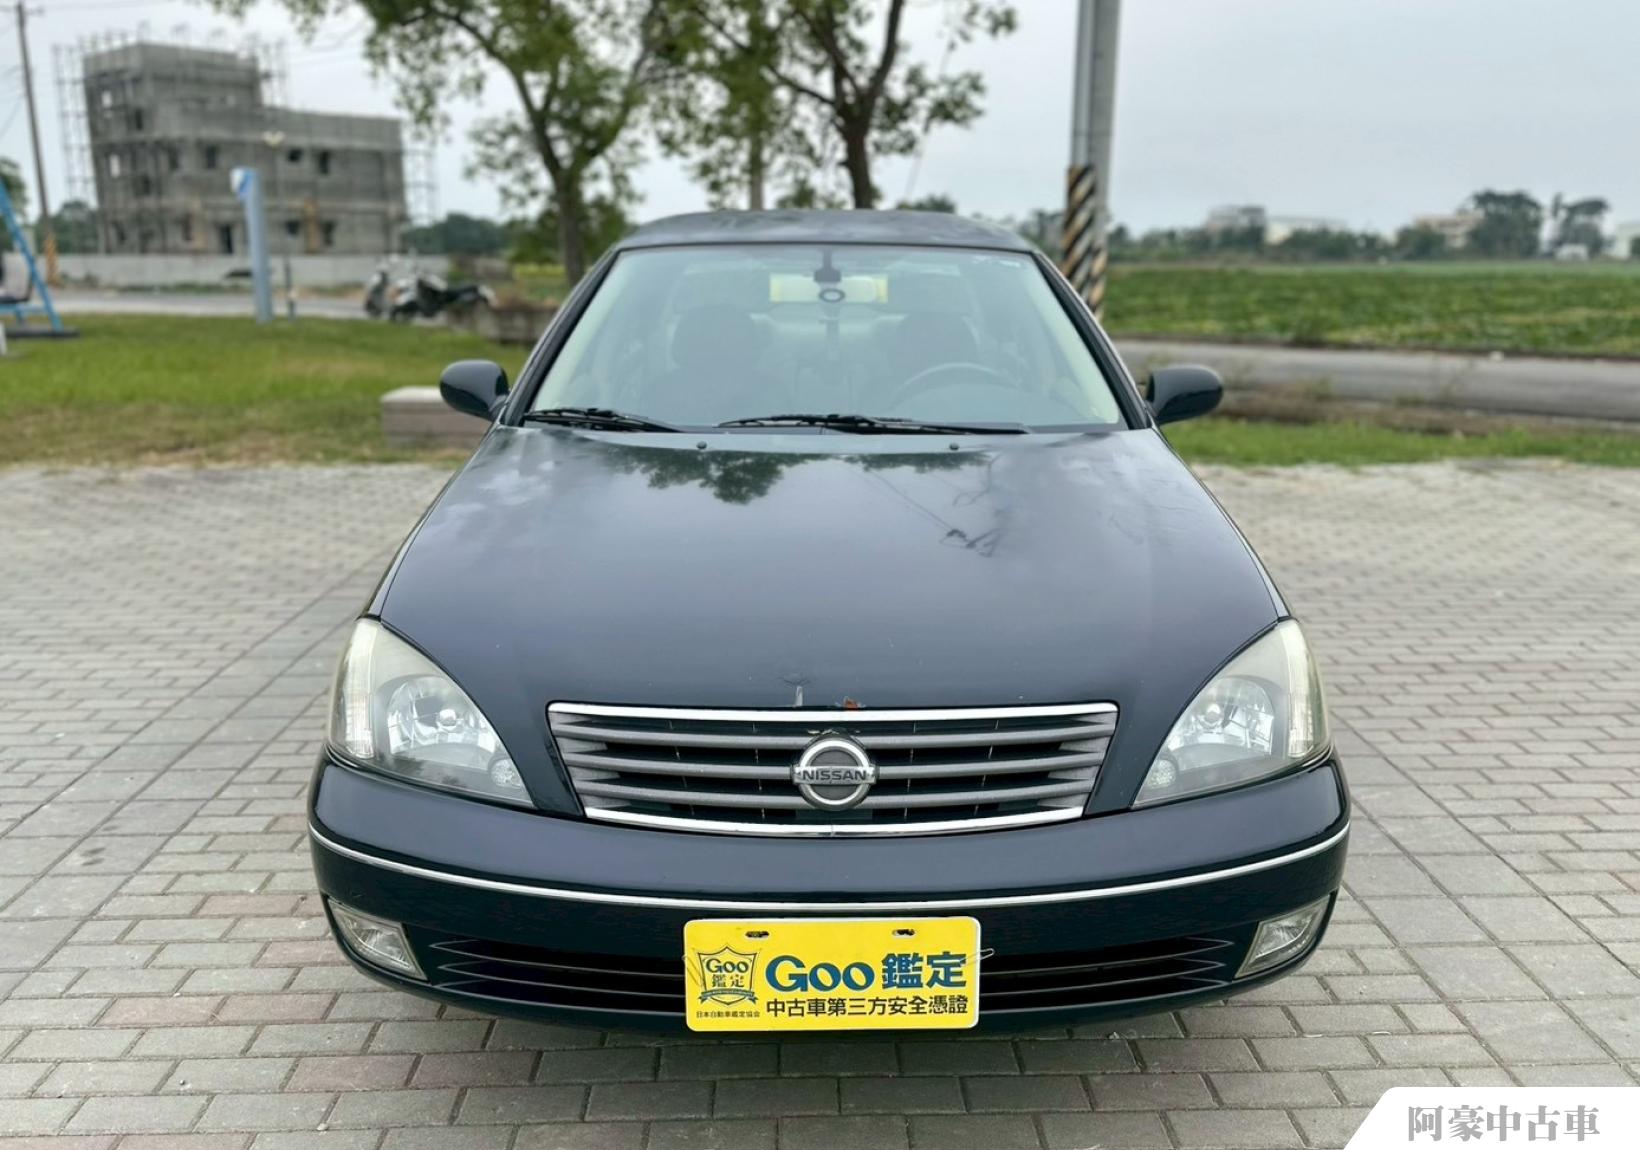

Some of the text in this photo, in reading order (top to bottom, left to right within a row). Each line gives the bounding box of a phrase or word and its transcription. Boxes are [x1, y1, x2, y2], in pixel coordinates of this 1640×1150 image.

[803, 769, 867, 781] NISSAN
[706, 958, 749, 973] Goo
[765, 951, 967, 992] Goo 鑑定
[766, 994, 968, 1017] 中古車第三方安全憑證
